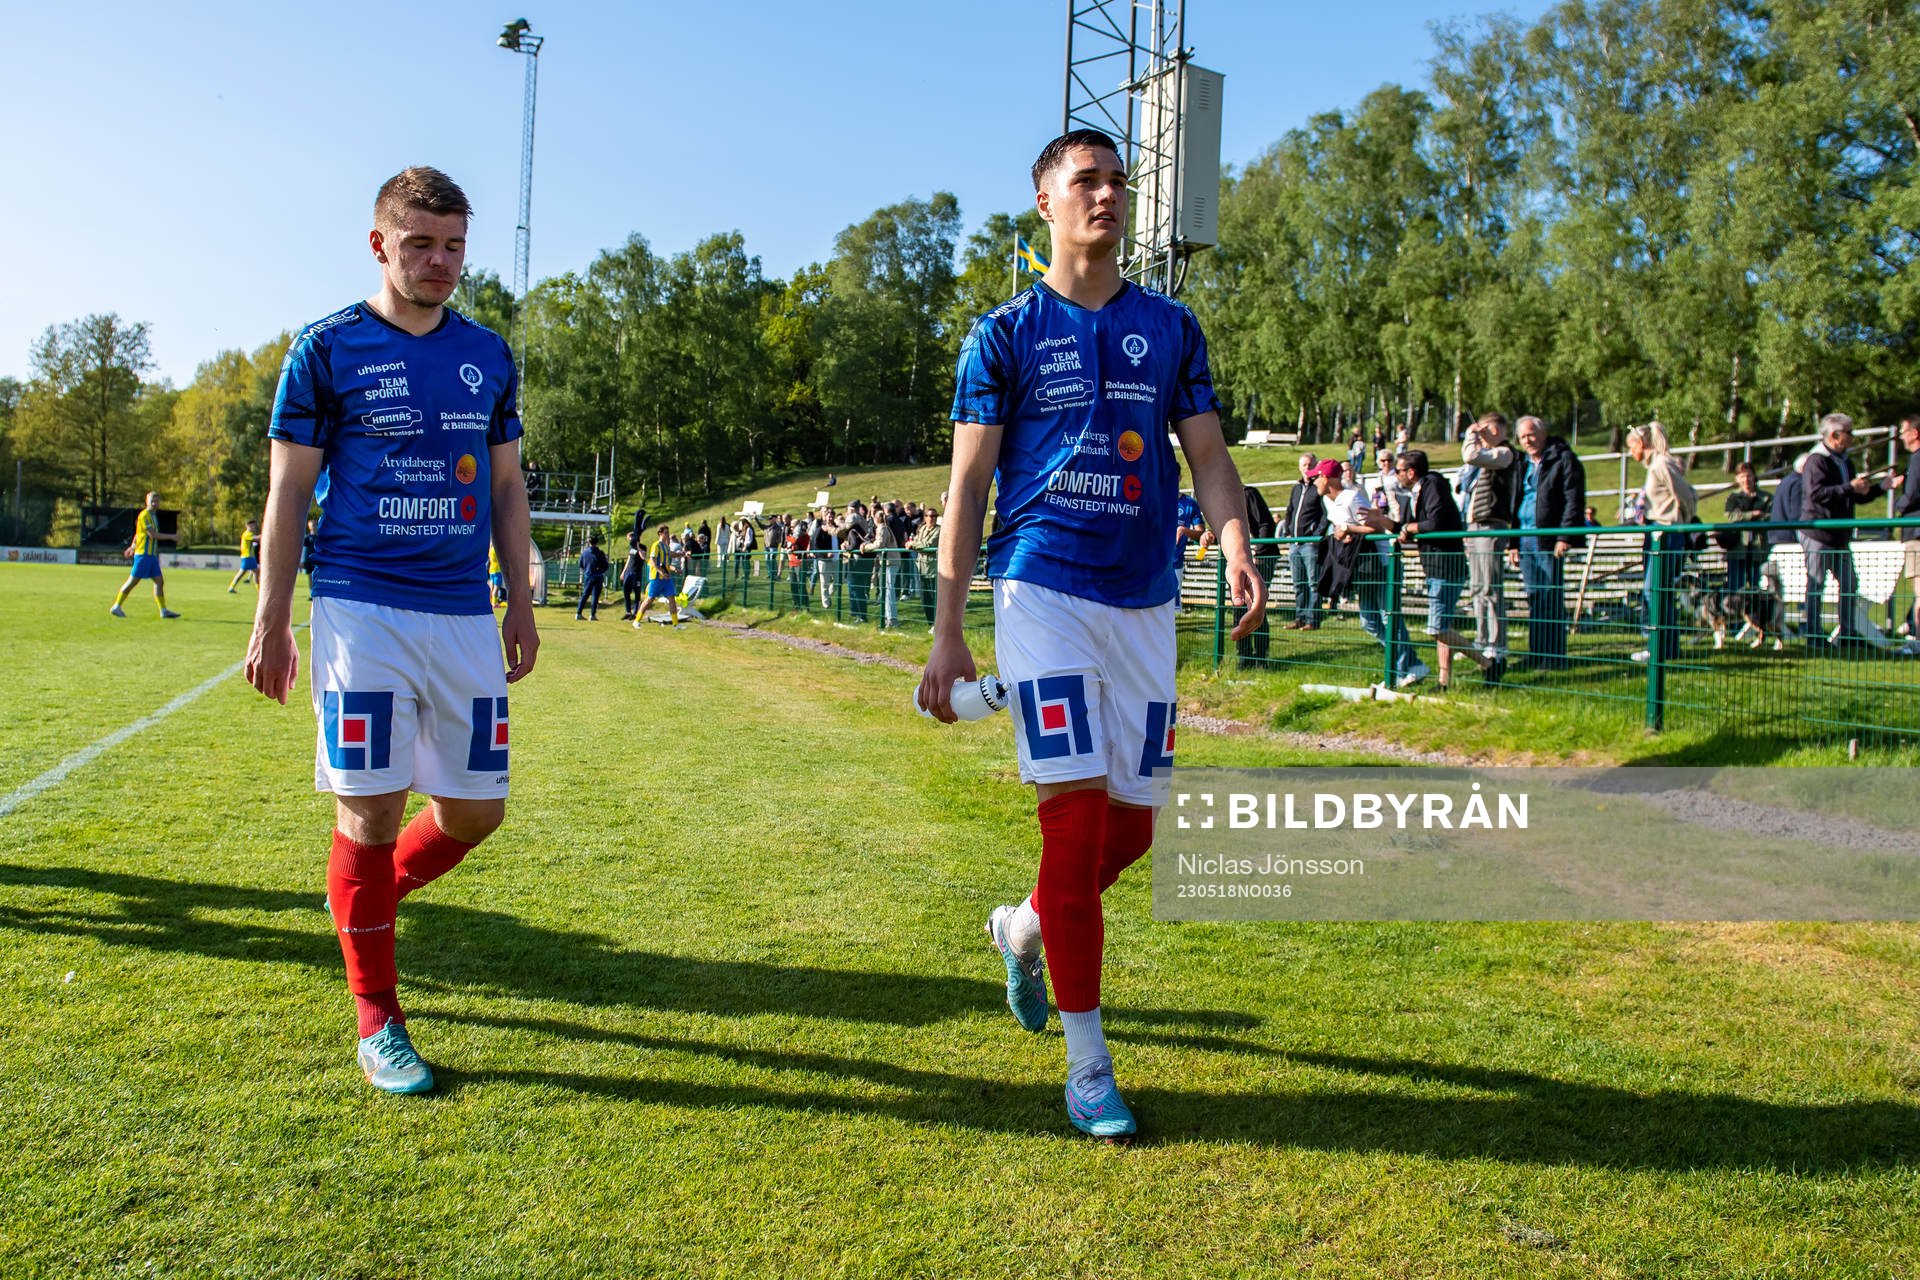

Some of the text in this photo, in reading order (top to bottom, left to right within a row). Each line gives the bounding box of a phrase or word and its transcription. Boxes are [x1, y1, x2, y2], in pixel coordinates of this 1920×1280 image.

[302, 309, 356, 340] MINEC
[1035, 335, 1077, 351] uhlsport
[1051, 351, 1080, 363] TEAM
[357, 361, 406, 376] uhlsport
[1039, 361, 1082, 375] SPORTIA
[379, 377, 408, 389] TEAM
[1105, 381, 1139, 391] Rolands
[365, 386, 410, 401] SPORTIA
[1106, 391, 1114, 400] &
[440, 412, 476, 421] Rolands
[442, 422, 451, 430] &
[380, 454, 446, 470] Åtvidabergs
[395, 471, 446, 484] Sparbank
[1047, 470, 1121, 497] COMFORT
[379, 496, 457, 520] COMFORT
[1043, 492, 1141, 517] TERNSTEDT INVENT
[379, 523, 476, 536] TERNSTEDT INVENT
